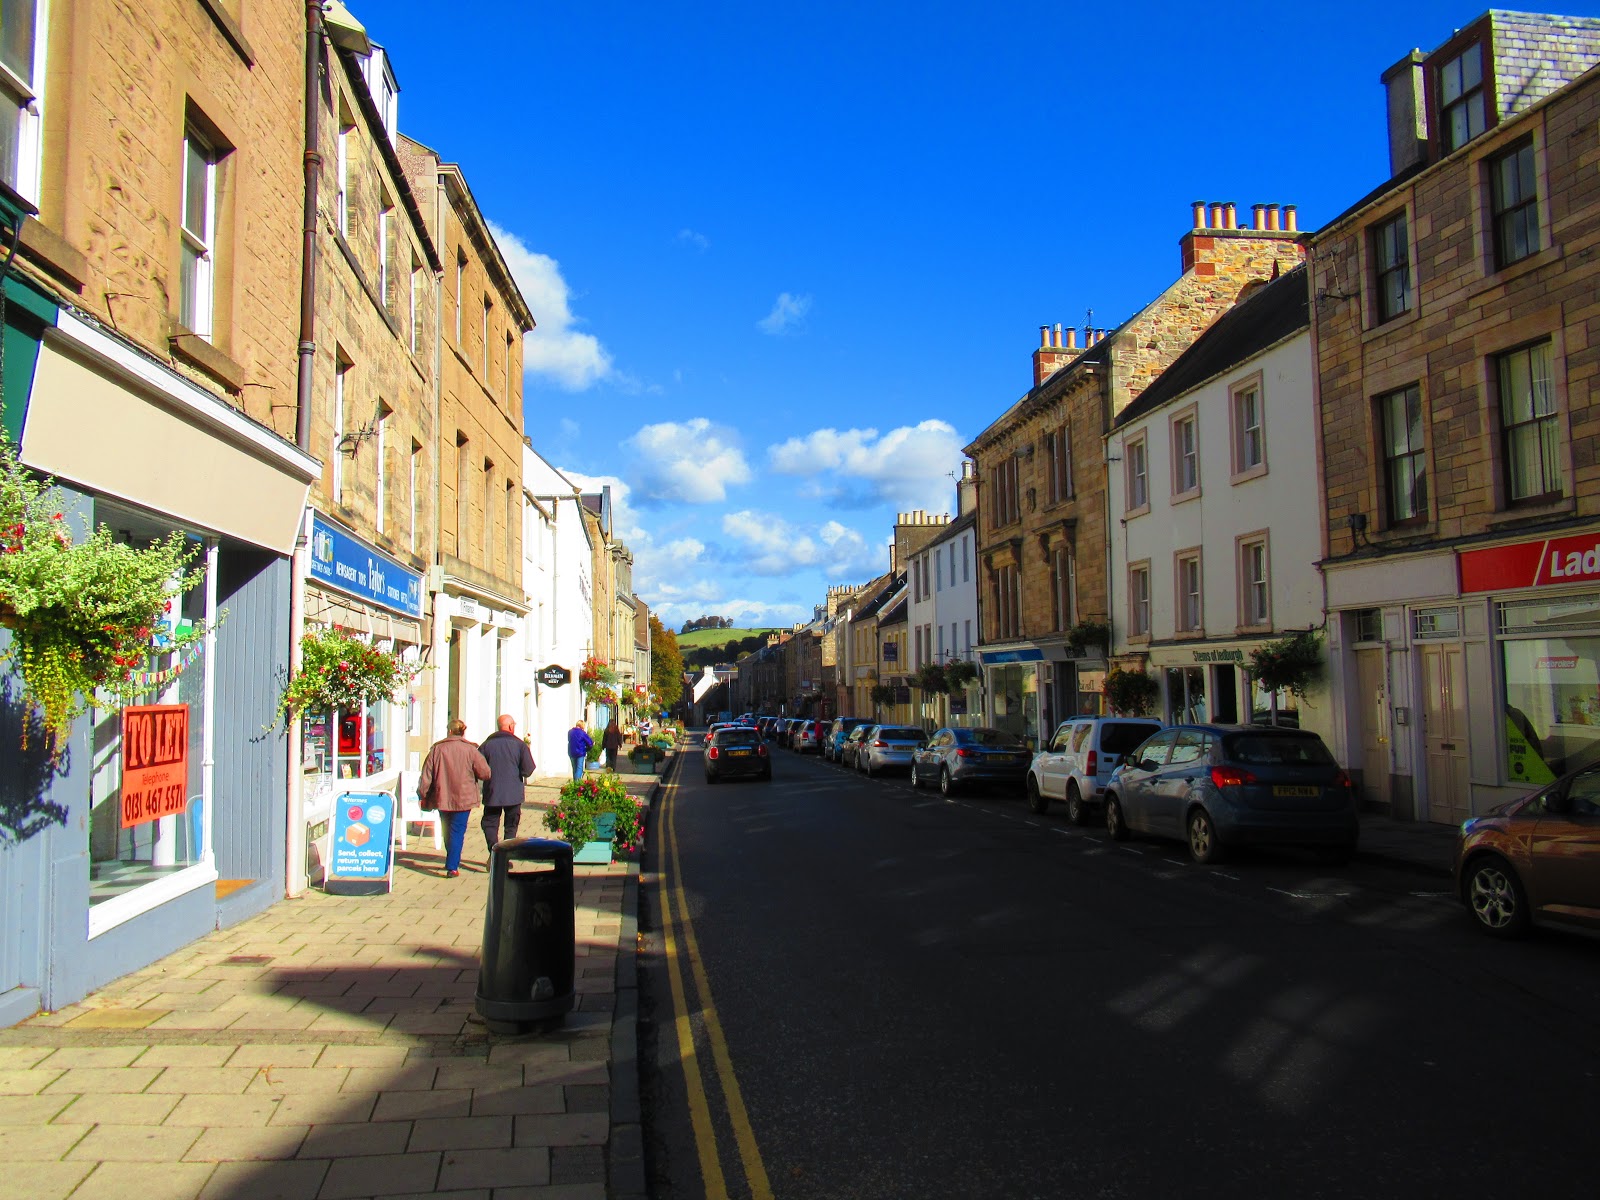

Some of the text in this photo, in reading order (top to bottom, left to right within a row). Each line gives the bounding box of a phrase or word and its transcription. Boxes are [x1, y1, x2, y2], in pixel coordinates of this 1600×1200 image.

[1550, 543, 1600, 578] Lad
[336, 561, 357, 582] NEWSAGENT
[358, 571, 366, 587] TOYS
[367, 557, 386, 597] Taylor's
[1192, 650, 1211, 662] Stems
[1538, 659, 1576, 668] Ladbrokes
[128, 712, 184, 767] TO LET
[142, 771, 169, 786] Telephone
[125, 784, 182, 821] 0131 467 5571
[338, 849, 383, 858] Send, collect,
